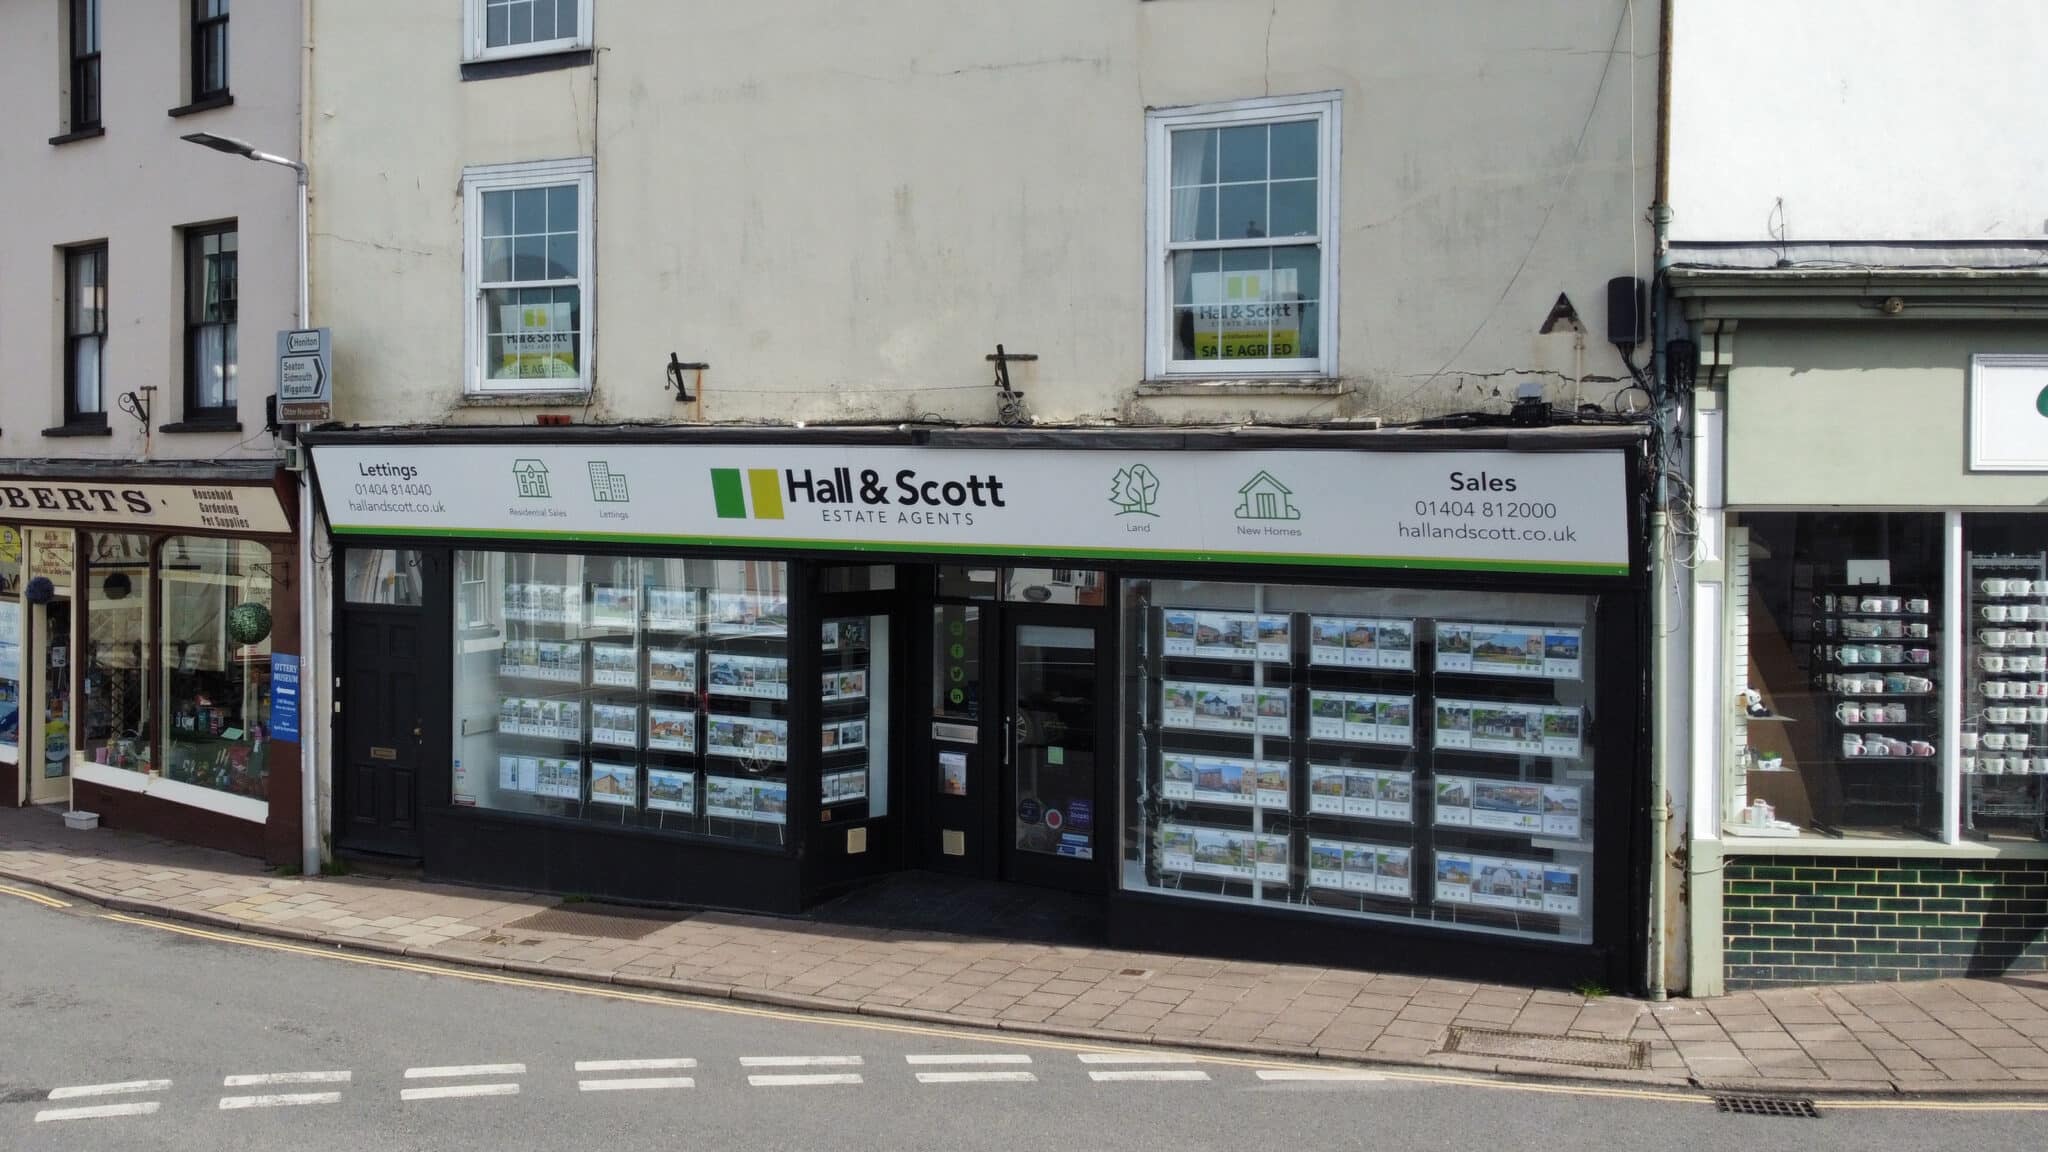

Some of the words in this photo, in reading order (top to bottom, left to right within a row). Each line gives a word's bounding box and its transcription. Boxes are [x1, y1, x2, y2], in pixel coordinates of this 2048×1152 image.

[1230, 304, 1243, 318] &
[294, 335, 318, 347] Honiton
[283, 361, 305, 371] Seaton
[359, 462, 418, 480] Lettings
[785, 467, 853, 503] Hall
[860, 469, 890, 505] &
[895, 469, 1005, 507] Scott
[1449, 471, 1517, 493] Sales
[192, 489, 234, 501] Household
[355, 483, 389, 496] 01404
[391, 484, 432, 496] 814040
[0, 486, 152, 514] BERTS
[349, 499, 446, 514] hallandscott.co.uk
[199, 502, 240, 515] Gardening
[509, 507, 547, 518] Residential
[548, 509, 567, 518] Sales
[600, 510, 629, 520] Lettings
[1414, 500, 1476, 518] 01404
[1482, 501, 1557, 519] 812000
[201, 515, 214, 526] Pet
[215, 516, 250, 528] Supplies
[822, 509, 888, 524] ESTATE
[898, 511, 974, 526] AGENTS
[1126, 522, 1151, 533] Land
[1236, 525, 1261, 536] New
[1264, 525, 1302, 537] Homes
[1398, 520, 1577, 543] hallandscott.co.uk
[274, 663, 297, 674] OTTERY
[273, 672, 299, 684] MUSEUM
